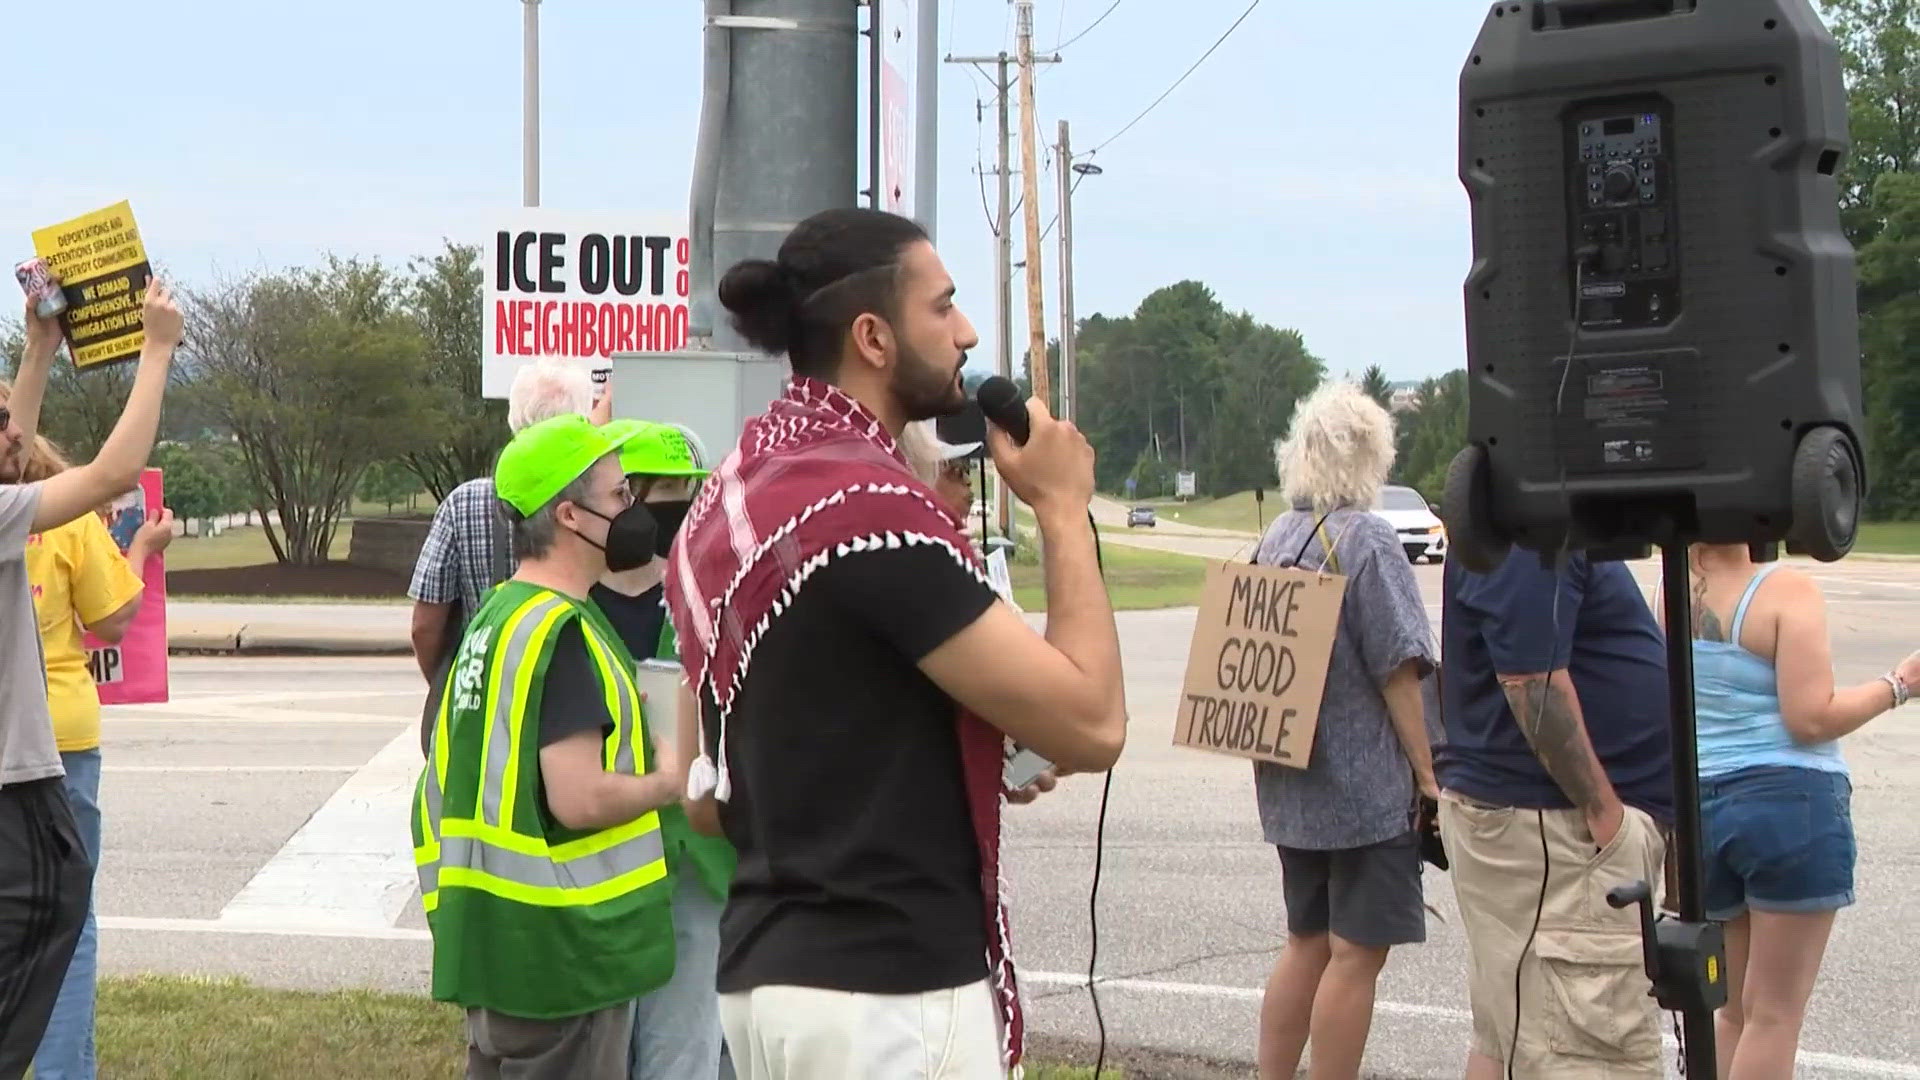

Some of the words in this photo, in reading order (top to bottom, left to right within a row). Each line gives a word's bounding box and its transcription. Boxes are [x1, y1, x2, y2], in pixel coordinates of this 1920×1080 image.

[47, 243, 93, 267] DETENTIONS
[93, 234, 125, 254] SEPARATE
[57, 221, 110, 248] DEPORTATIONS
[60, 258, 92, 280] DESTROY
[93, 246, 139, 270] COMMUNITIES
[497, 231, 566, 293] ICE
[579, 233, 671, 296] OUT
[82, 286, 96, 301] WE
[97, 276, 131, 297] DEMAND
[1226, 574, 1305, 637] MAKE
[1217, 637, 1296, 697] GOOD
[1187, 694, 1297, 758] TROUBLE
